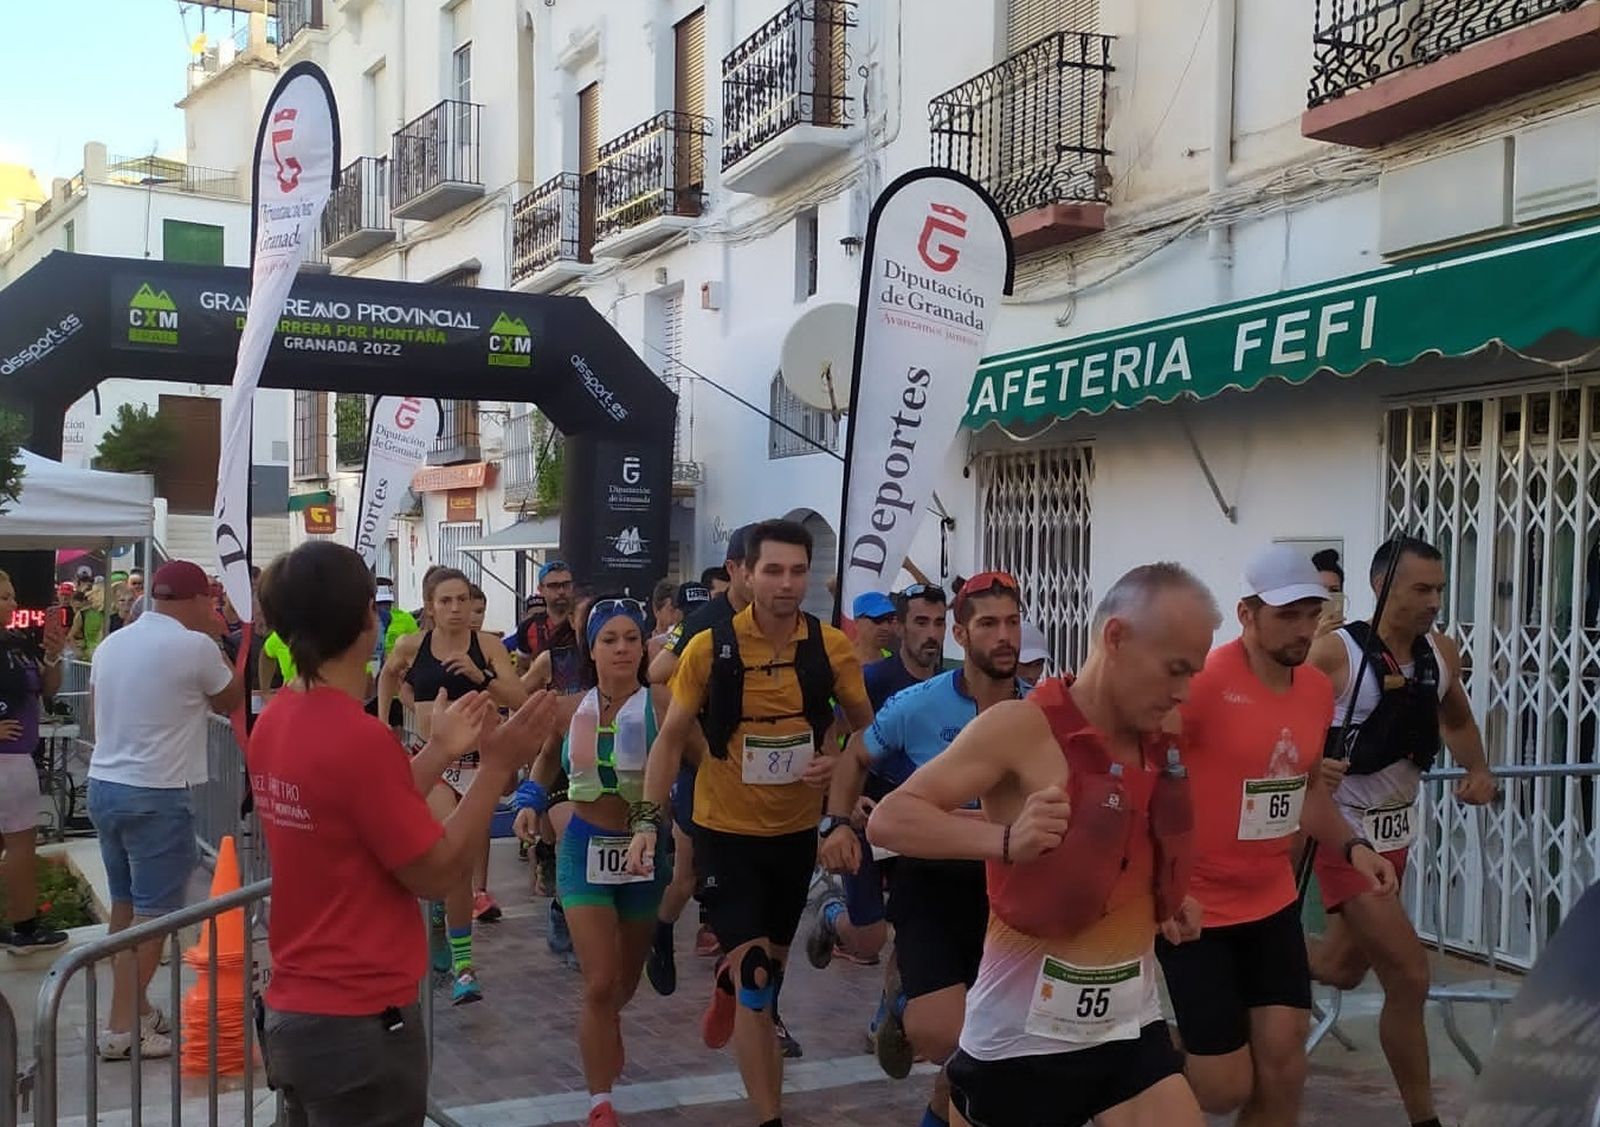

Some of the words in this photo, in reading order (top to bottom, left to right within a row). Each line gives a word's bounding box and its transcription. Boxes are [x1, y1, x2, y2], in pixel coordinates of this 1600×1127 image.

[260, 223, 301, 251] Granad
[884, 259, 984, 309] Diputación
[129, 308, 178, 329] CXM
[282, 298, 350, 320] REMIO
[357, 303, 480, 330] PROVINCIAL
[880, 284, 905, 306] de
[908, 291, 984, 331] Granada
[235, 316, 247, 330] D
[276, 319, 332, 337] RRERA
[336, 324, 368, 340] POR
[373, 326, 446, 345] MONTAÑA
[489, 334, 531, 354] CXM
[283, 336, 358, 354] GRANADA
[363, 341, 402, 357] 2022
[972, 336, 1192, 416] AFETERIA
[1233, 296, 1377, 372] FEFI
[850, 366, 931, 577] Deportes
[768, 751, 794, 775] 87
[1269, 793, 1291, 818] 65
[1371, 811, 1411, 841] 1034
[598, 848, 631, 872] 102
[1076, 987, 1111, 1018] 55
